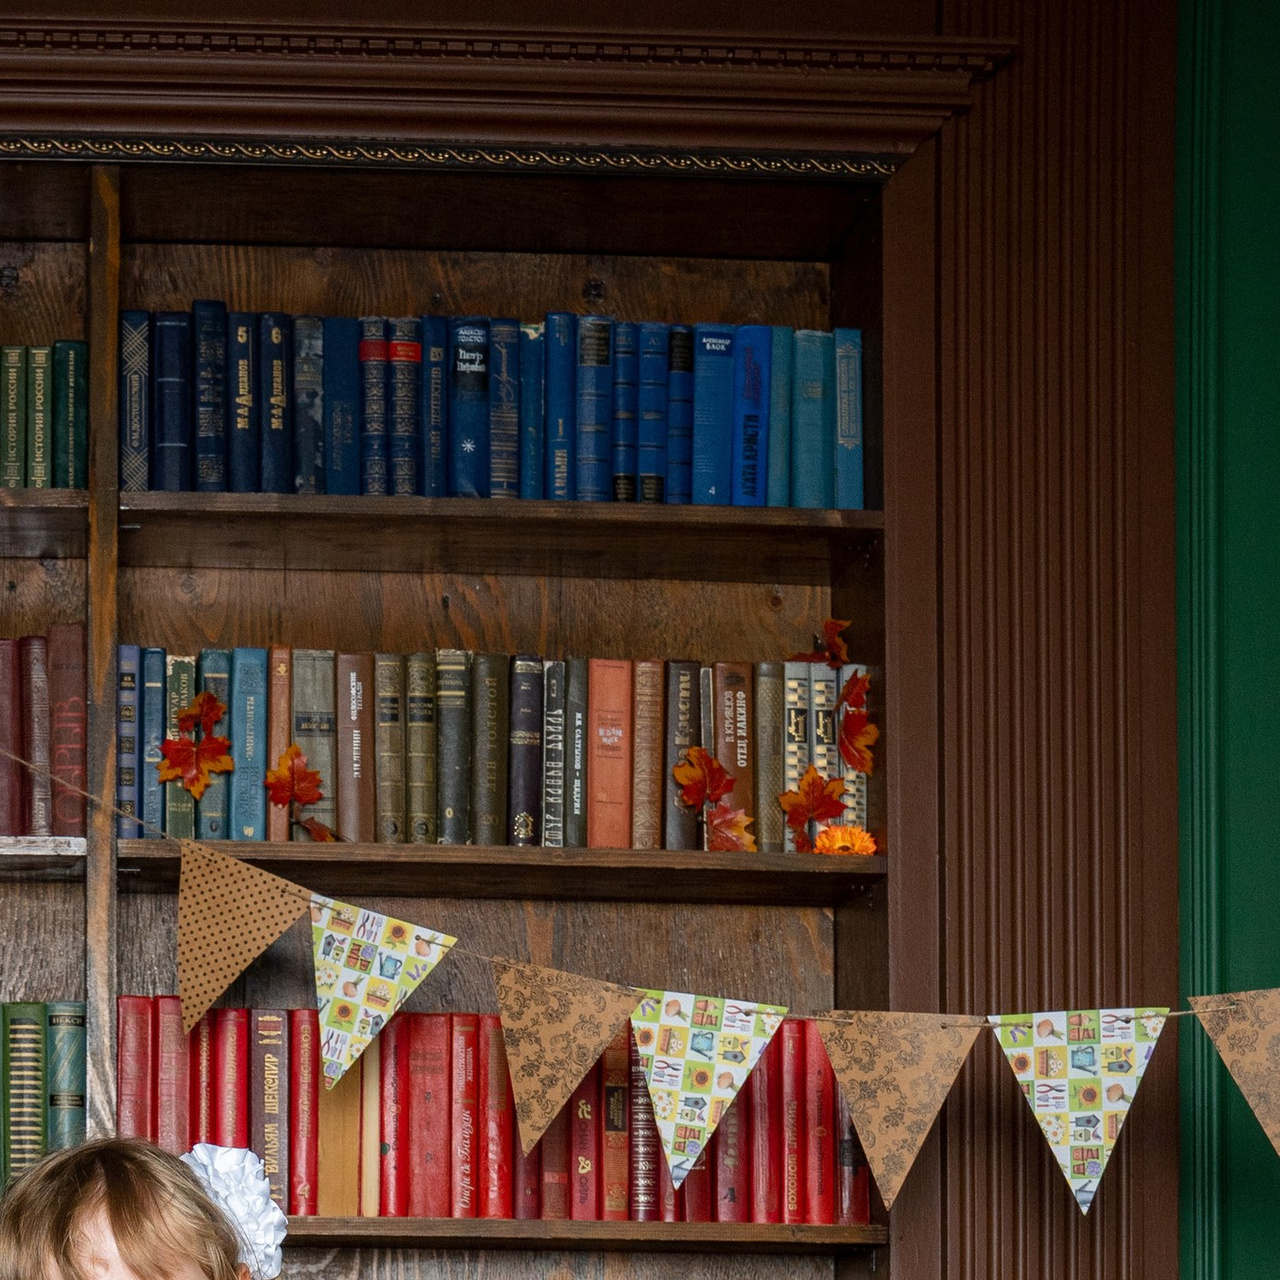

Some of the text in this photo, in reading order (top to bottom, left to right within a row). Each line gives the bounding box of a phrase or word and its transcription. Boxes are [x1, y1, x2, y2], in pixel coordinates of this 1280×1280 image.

[238, 326, 248, 343] 5
[271, 327, 281, 343] 6
[708, 486, 716, 496] 4
[735, 690, 747, 767] ОТЕЦ ИАКИНФ
[263, 1053, 279, 1176] ВИЛЬЯМ ШЕКСПИР
